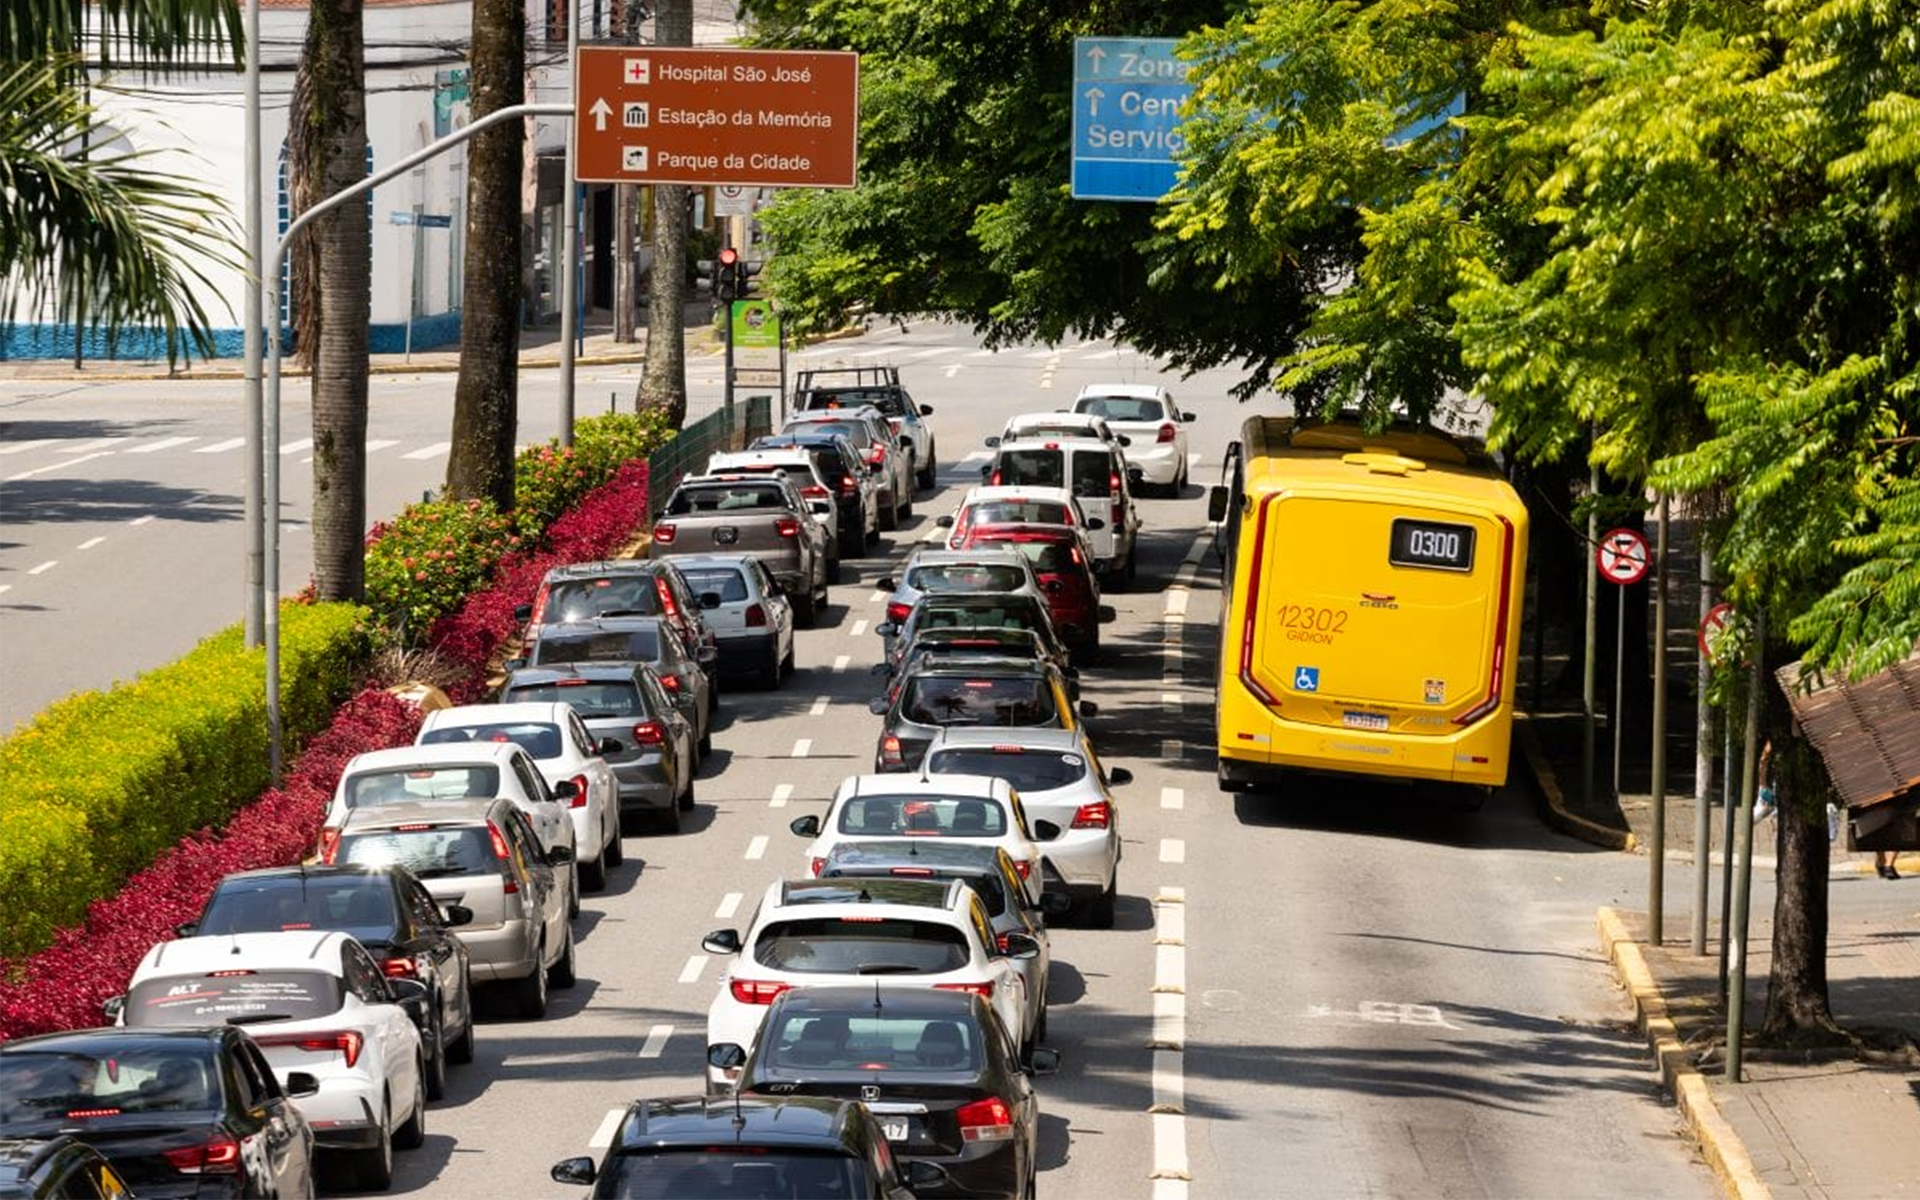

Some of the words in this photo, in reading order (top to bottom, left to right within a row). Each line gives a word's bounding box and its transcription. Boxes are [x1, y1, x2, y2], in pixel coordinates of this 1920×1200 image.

[659, 64, 727, 83] Hospital
[733, 65, 766, 82] São
[772, 66, 811, 83] José
[1118, 53, 1188, 78] Zona
[658, 107, 727, 128] Estação
[732, 109, 752, 126] da
[758, 110, 832, 128] Memória
[1087, 123, 1187, 153] Serviç
[657, 151, 718, 172] Parque
[723, 152, 744, 169] da
[750, 153, 810, 170] Cidade
[1411, 530, 1459, 558] 0300
[1277, 605, 1348, 633] 12302
[1287, 629, 1334, 645] GIDION
[167, 983, 202, 997] ALT
